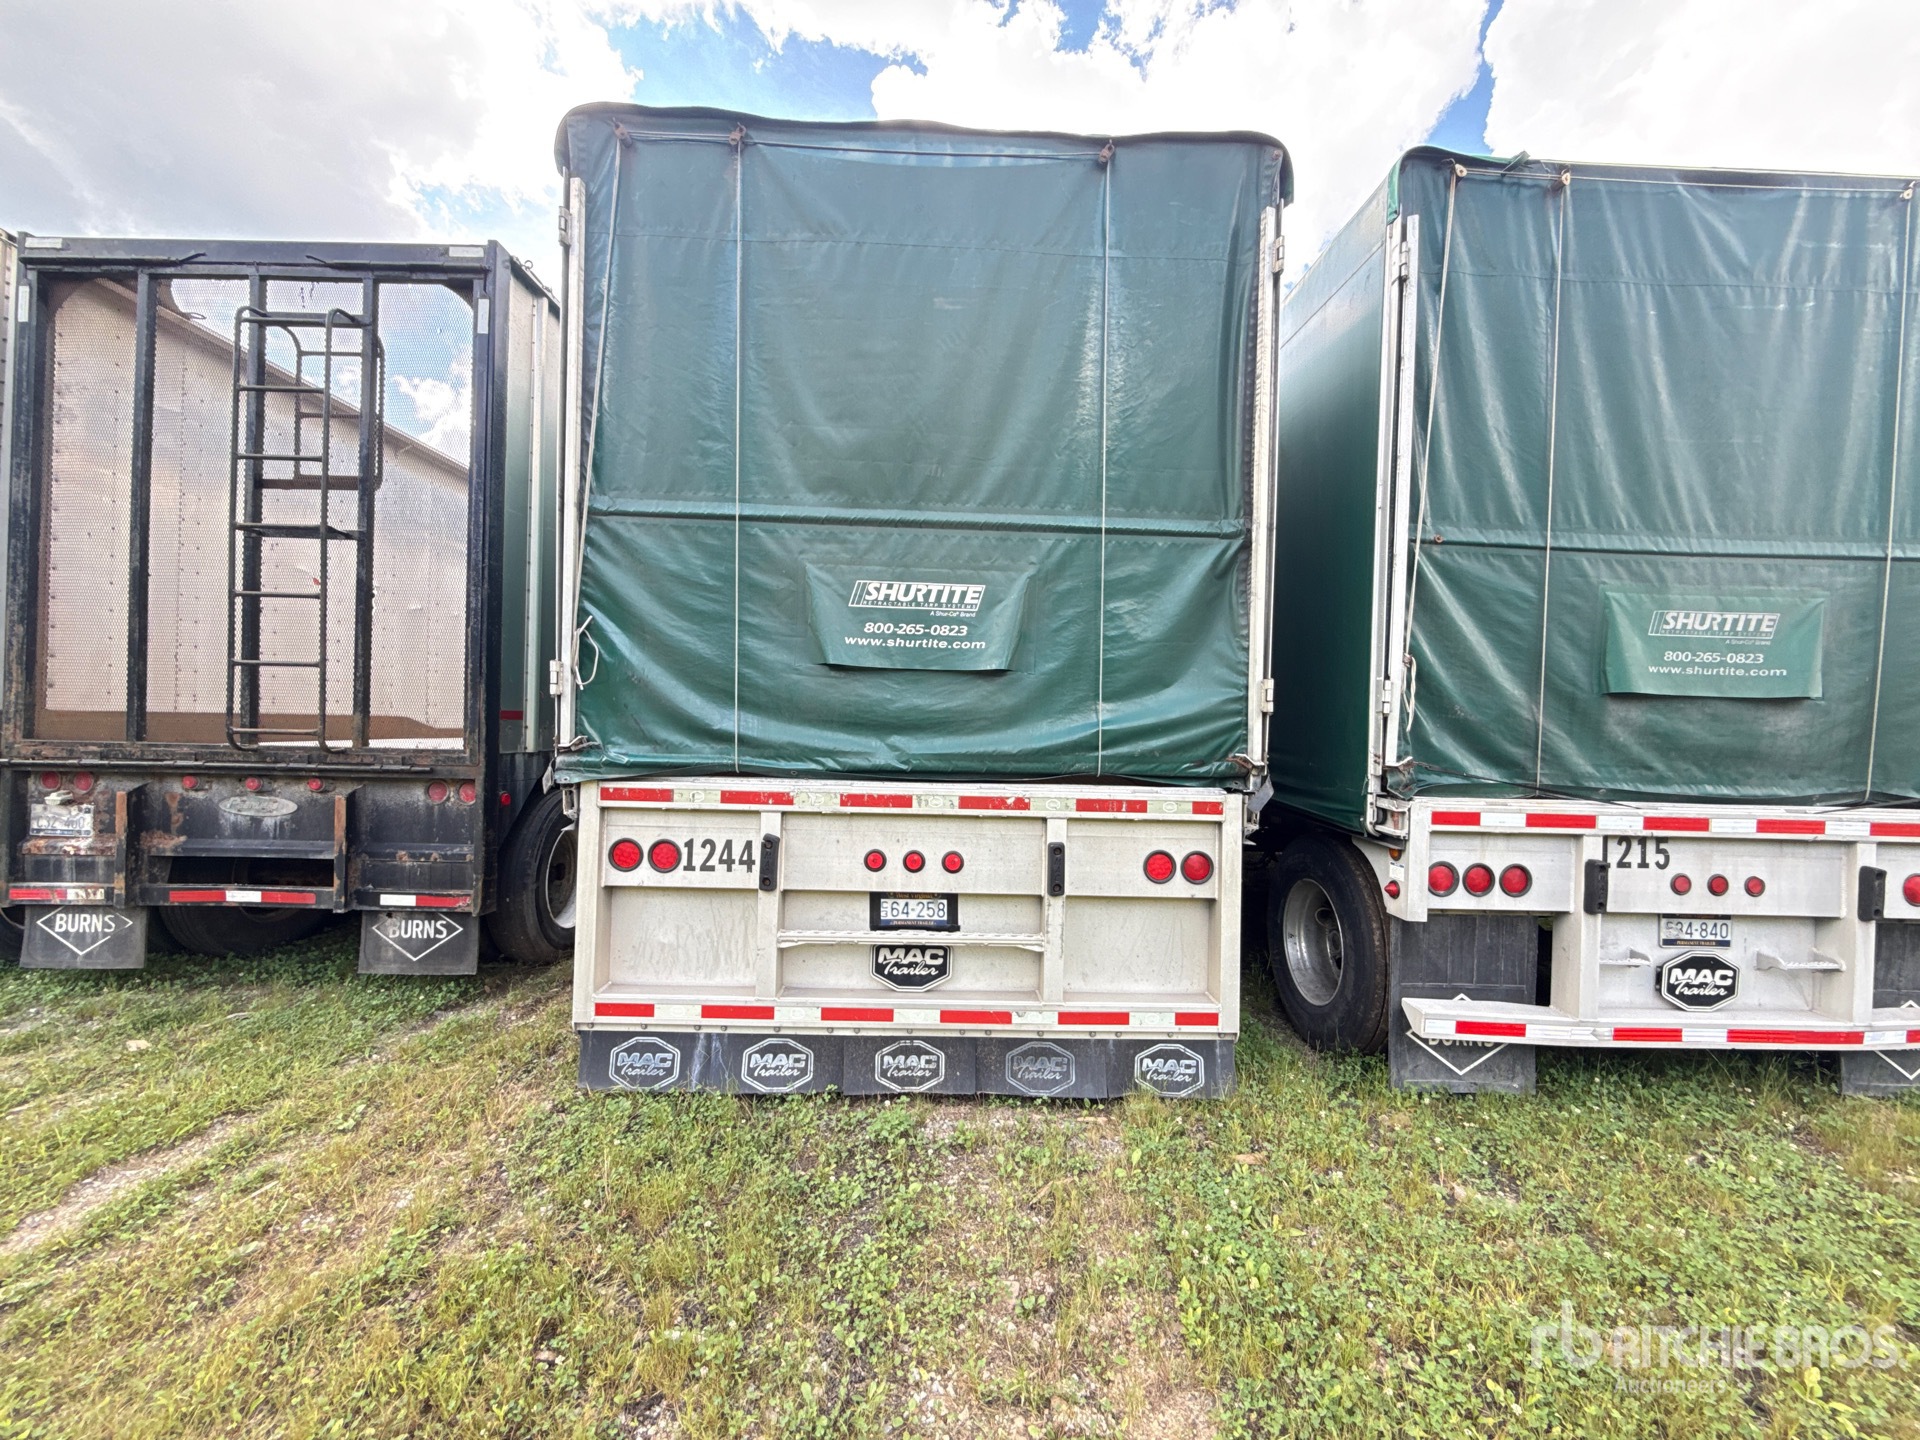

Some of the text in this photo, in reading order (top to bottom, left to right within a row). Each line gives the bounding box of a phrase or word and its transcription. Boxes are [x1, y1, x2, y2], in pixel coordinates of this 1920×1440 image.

[864, 582, 983, 604] SHURTITE
[863, 622, 968, 636] 800-265-0823
[1662, 611, 1777, 632] SHURTITE
[844, 636, 986, 649] www.shurtite.com
[1663, 650, 1765, 664] 800-265-0823
[1648, 665, 1787, 676] www.shurtite.com
[683, 838, 756, 873] 1244
[890, 901, 946, 919] 64-258
[54, 913, 116, 933] BURNS
[387, 919, 448, 939] BURNS
[878, 947, 945, 965] MAC
[883, 958, 939, 975] Trailer
[1669, 968, 1734, 986] MAC
[1674, 979, 1728, 996] Trailer
[617, 1052, 674, 1068] MAC
[619, 1060, 667, 1077] Trailer
[749, 1053, 807, 1068] MAC
[882, 1054, 938, 1069] MAC
[1013, 1055, 1068, 1072] MAC
[1142, 1058, 1197, 1074] MAC
[752, 1061, 801, 1077] Trailer
[886, 1062, 932, 1077] Trailer
[1144, 1066, 1193, 1082] Trailer
